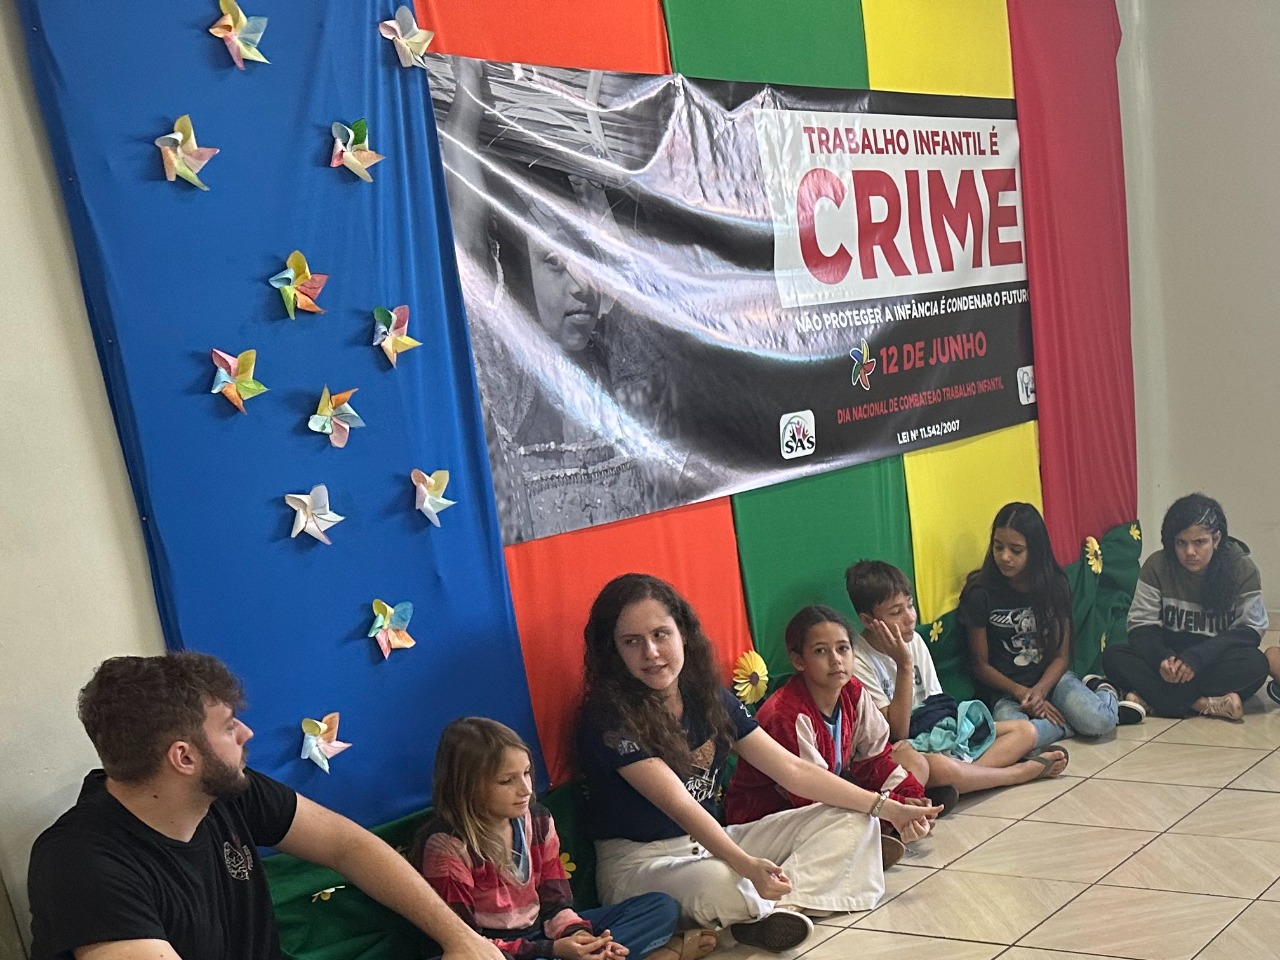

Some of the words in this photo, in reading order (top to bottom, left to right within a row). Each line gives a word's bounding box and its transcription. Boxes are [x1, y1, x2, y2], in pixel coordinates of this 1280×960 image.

[803, 126, 908, 154] TRABALHO
[913, 130, 986, 155] INFANTIL
[990, 125, 1000, 156] É
[797, 167, 1023, 284] CRIME
[795, 311, 822, 333] NÃO
[823, 308, 883, 329] PROTEGER
[885, 306, 894, 322] A
[894, 300, 938, 320] INFÂNCIA
[940, 295, 946, 314] É
[947, 292, 992, 312] CONDENAR
[994, 292, 1000, 306] O
[880, 347, 898, 374] 12
[904, 341, 924, 370] DE
[929, 331, 987, 366] JUNHO
[837, 408, 852, 424] DIA
[852, 401, 888, 420] NACIONAL
[889, 398, 899, 411] DE
[942, 382, 977, 401] TRABALHO
[977, 377, 1004, 393] INFANTIL
[784, 435, 815, 453] SAS
[897, 432, 910, 444] LEI
